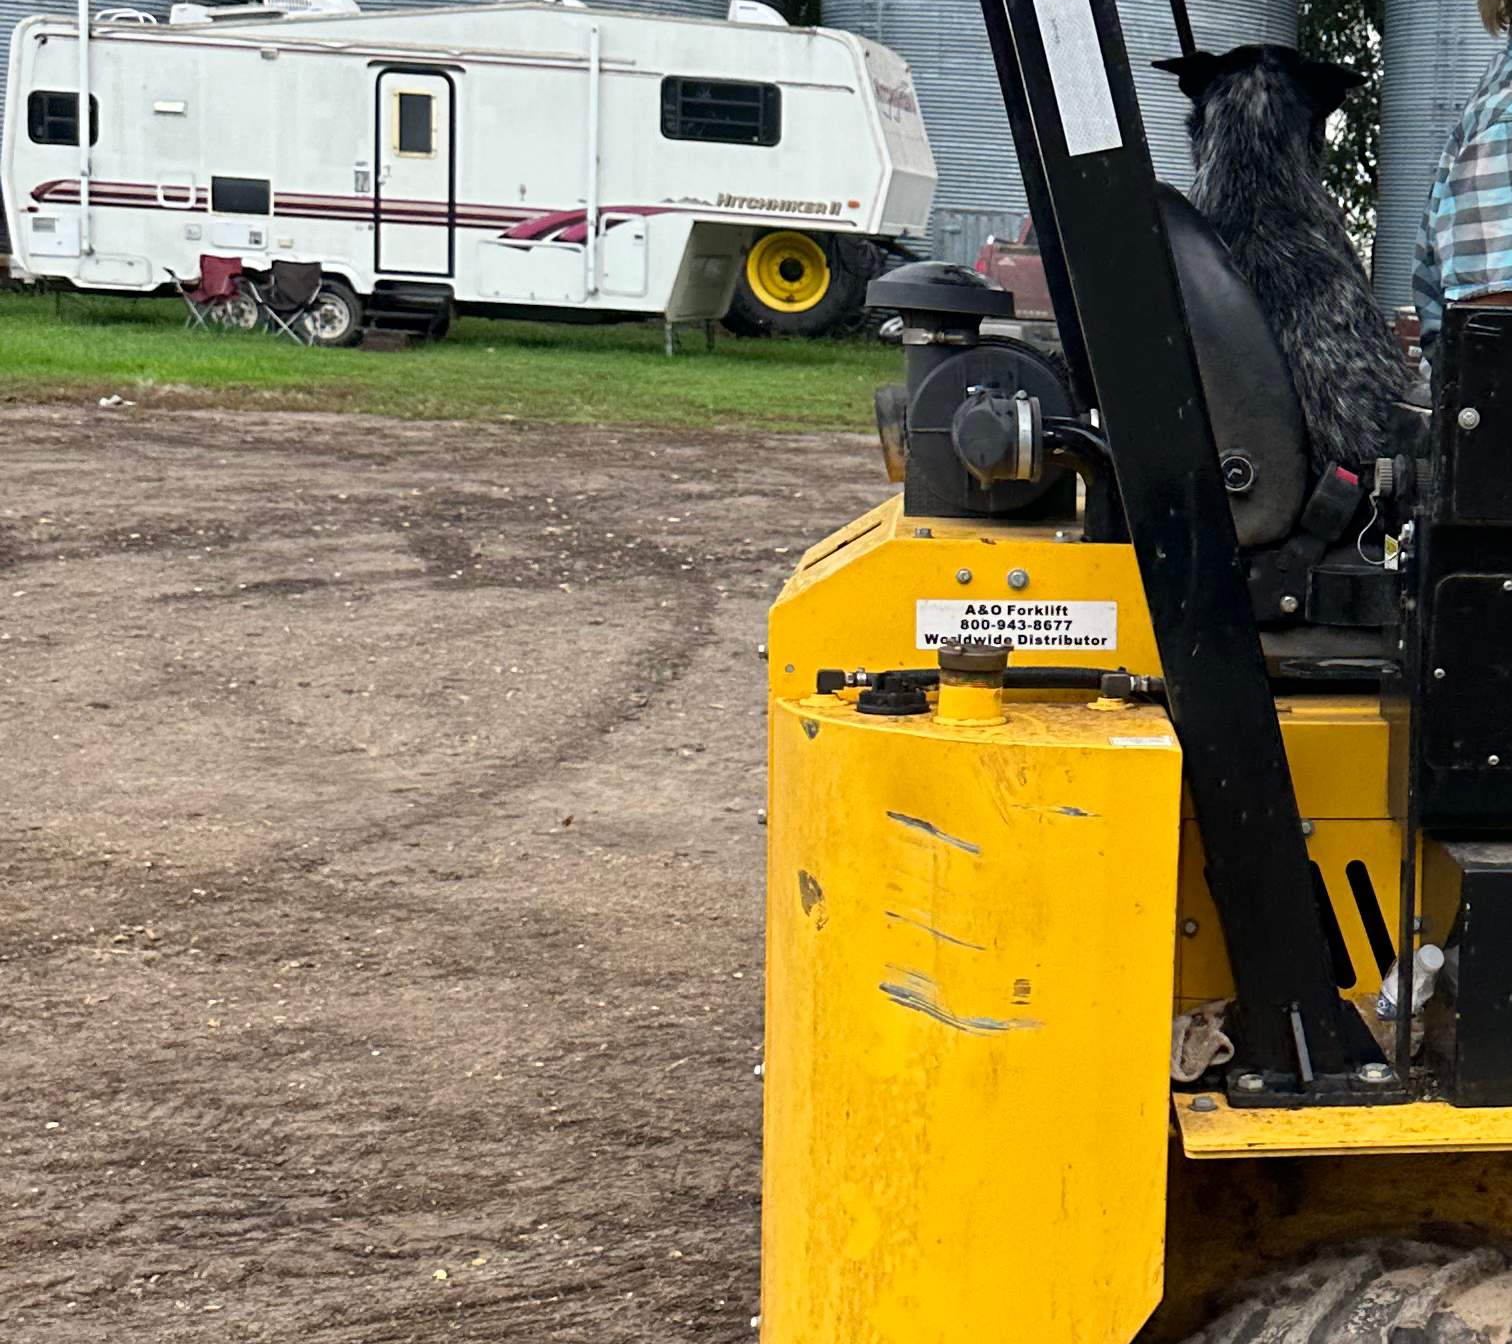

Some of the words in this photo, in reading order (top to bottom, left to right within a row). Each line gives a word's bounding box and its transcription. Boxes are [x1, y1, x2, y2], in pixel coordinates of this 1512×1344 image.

[965, 604, 1002, 616] A&O
[1007, 605, 1069, 616] Forklift
[960, 619, 1073, 631] 800-943-8677
[1017, 634, 1108, 646] Distributor
